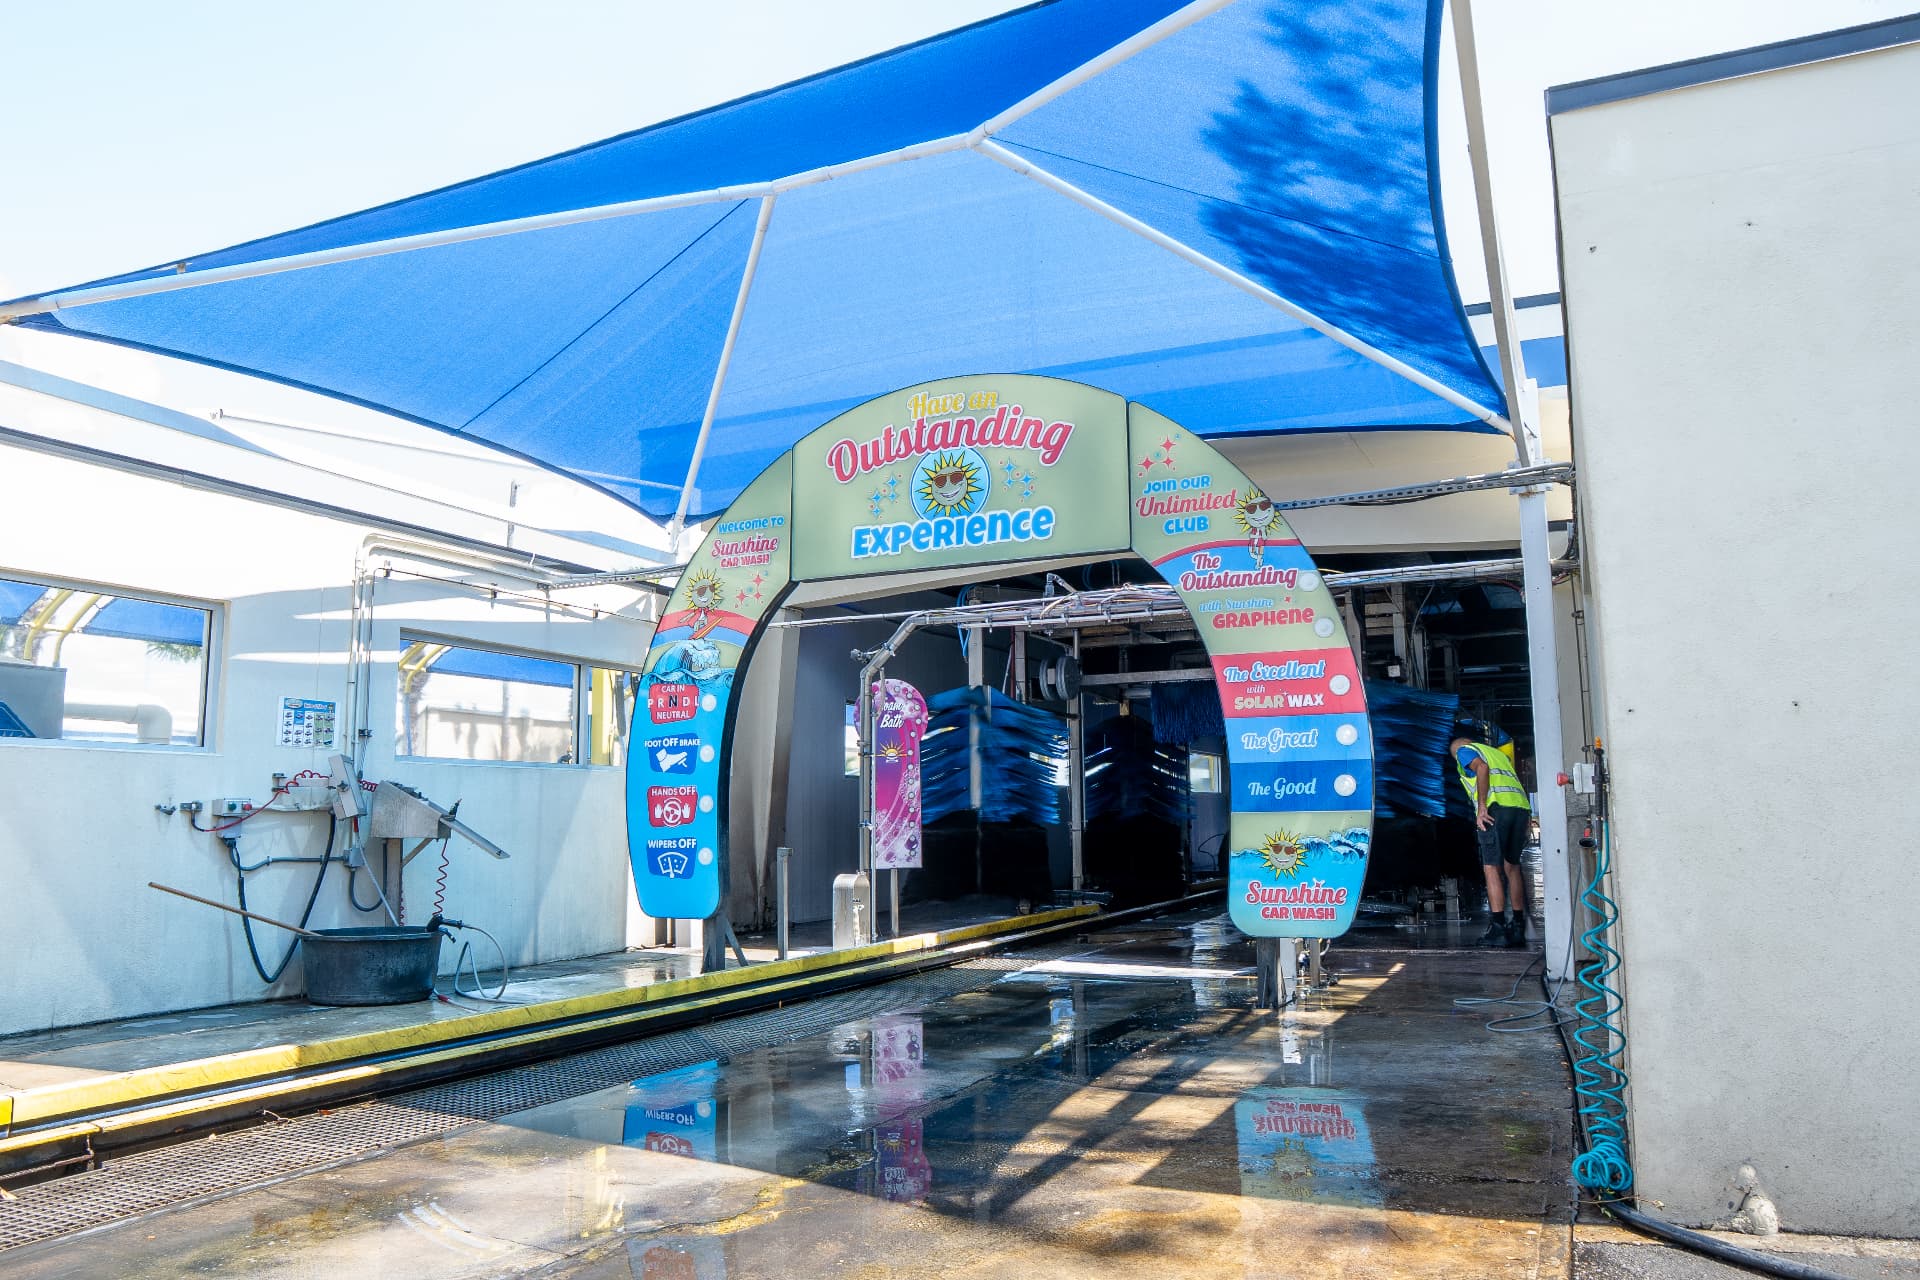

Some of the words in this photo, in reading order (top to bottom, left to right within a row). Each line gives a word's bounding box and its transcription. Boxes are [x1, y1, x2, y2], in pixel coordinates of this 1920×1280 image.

[908, 392, 964, 418] Have
[968, 391, 997, 410] an
[827, 405, 1073, 482] Outstanding
[1181, 475, 1210, 490] OUR
[1136, 489, 1237, 517] Unlimited
[771, 516, 784, 526] TO
[1163, 516, 1209, 535] CLUB
[711, 534, 778, 558] Sunshine
[720, 556, 738, 568] CAR
[741, 553, 770, 566] WASH
[1193, 553, 1221, 571] The
[1180, 566, 1298, 592] Outstanding
[1200, 599, 1223, 612] with
[1225, 598, 1273, 610] Sunshine
[1223, 665, 1249, 682] The
[1250, 659, 1326, 682] Excellent
[661, 685, 676, 693] CAR
[677, 684, 685, 693] IN
[1247, 684, 1265, 694] with
[1234, 694, 1284, 710] SOLAR
[1287, 693, 1325, 708] WAX
[657, 710, 690, 720] NEUTRAL
[880, 714, 905, 728] Bath
[645, 739, 661, 748] FOOT
[662, 737, 679, 747] OFF
[679, 738, 701, 747] BRAKE
[1241, 732, 1267, 749] The
[1267, 728, 1318, 752] Great
[651, 787, 678, 796] HANDS
[679, 786, 697, 796] OFF
[1248, 782, 1271, 796] The
[1273, 777, 1316, 799] Good
[648, 839, 677, 849] WIPERS
[678, 838, 697, 849] OFF
[1246, 880, 1348, 906] Sunshine
[1261, 906, 1290, 921] CAR
[1290, 906, 1336, 921] WASH
